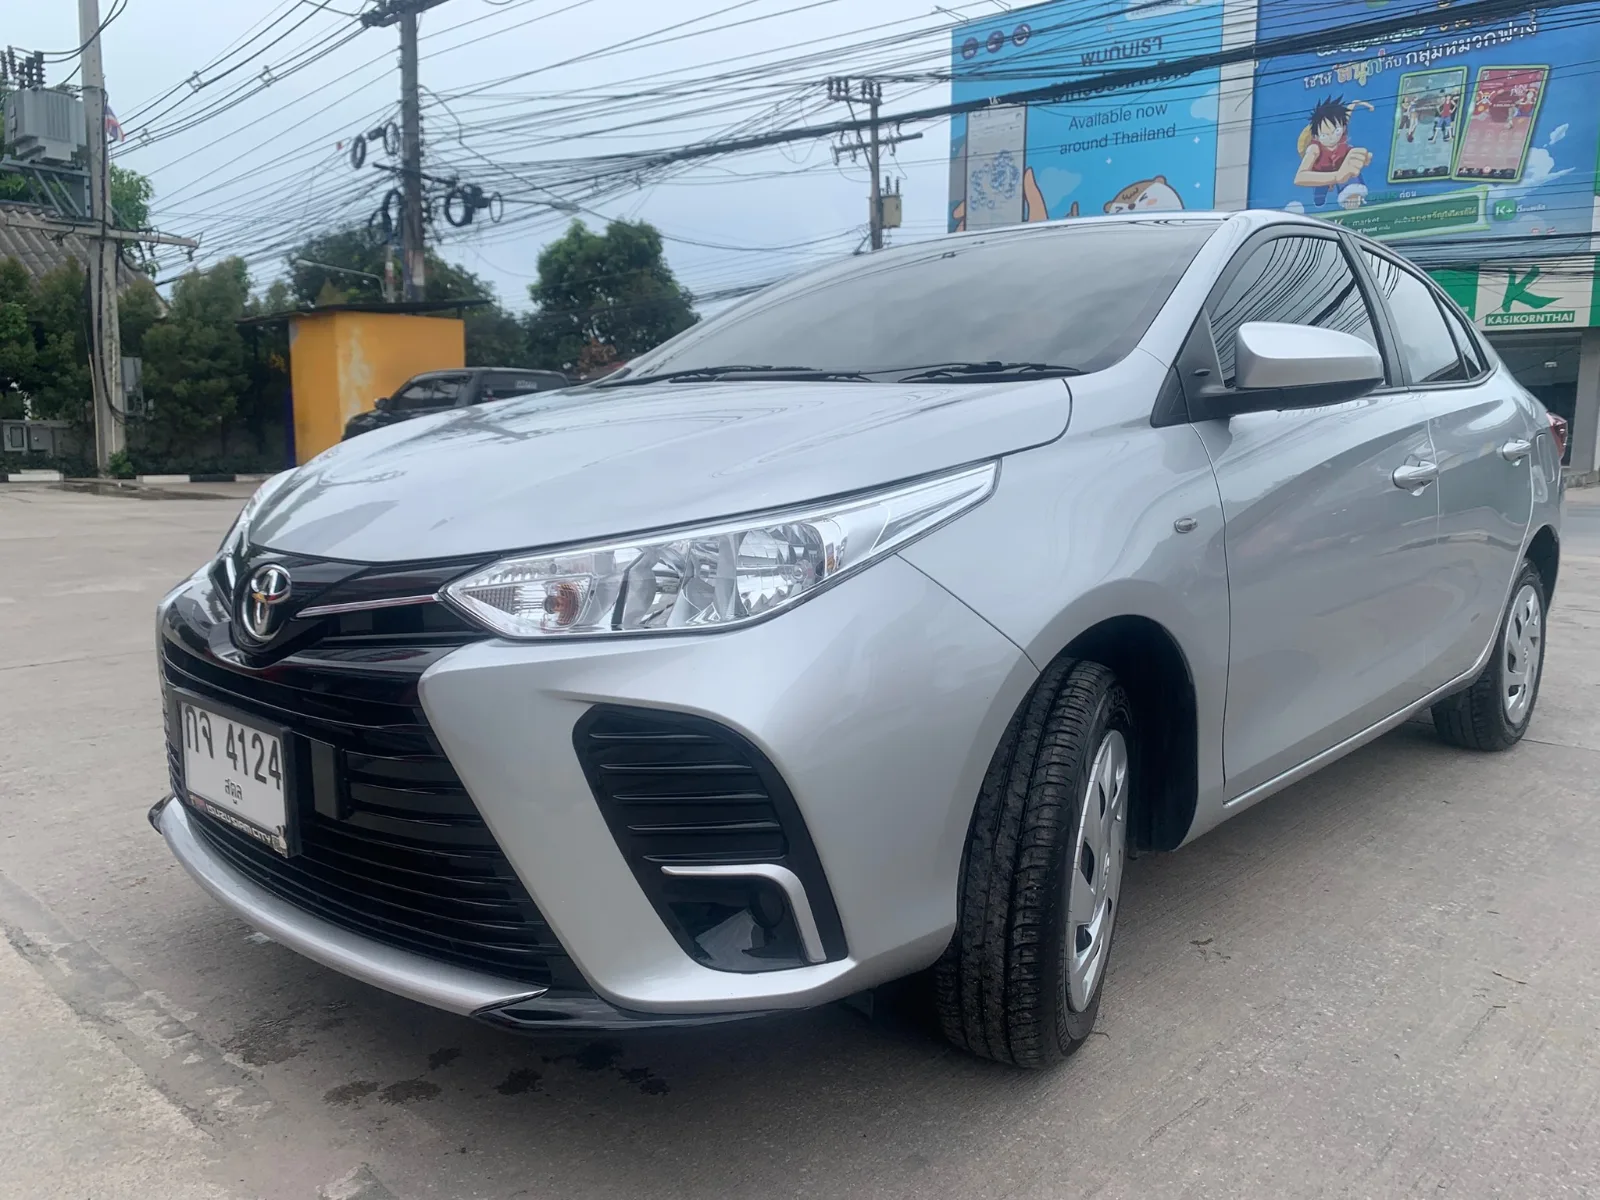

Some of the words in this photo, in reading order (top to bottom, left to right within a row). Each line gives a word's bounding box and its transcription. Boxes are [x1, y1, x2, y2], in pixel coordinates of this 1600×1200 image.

[1068, 107, 1132, 131] Available
[1136, 103, 1168, 119] now
[1060, 133, 1108, 155] around
[1112, 123, 1176, 146] Thailand
[1487, 313, 1573, 325] KASIKORNTHAI
[185, 705, 214, 759] กจ
[226, 723, 282, 790] 4124
[224, 778, 243, 805] สตูล
